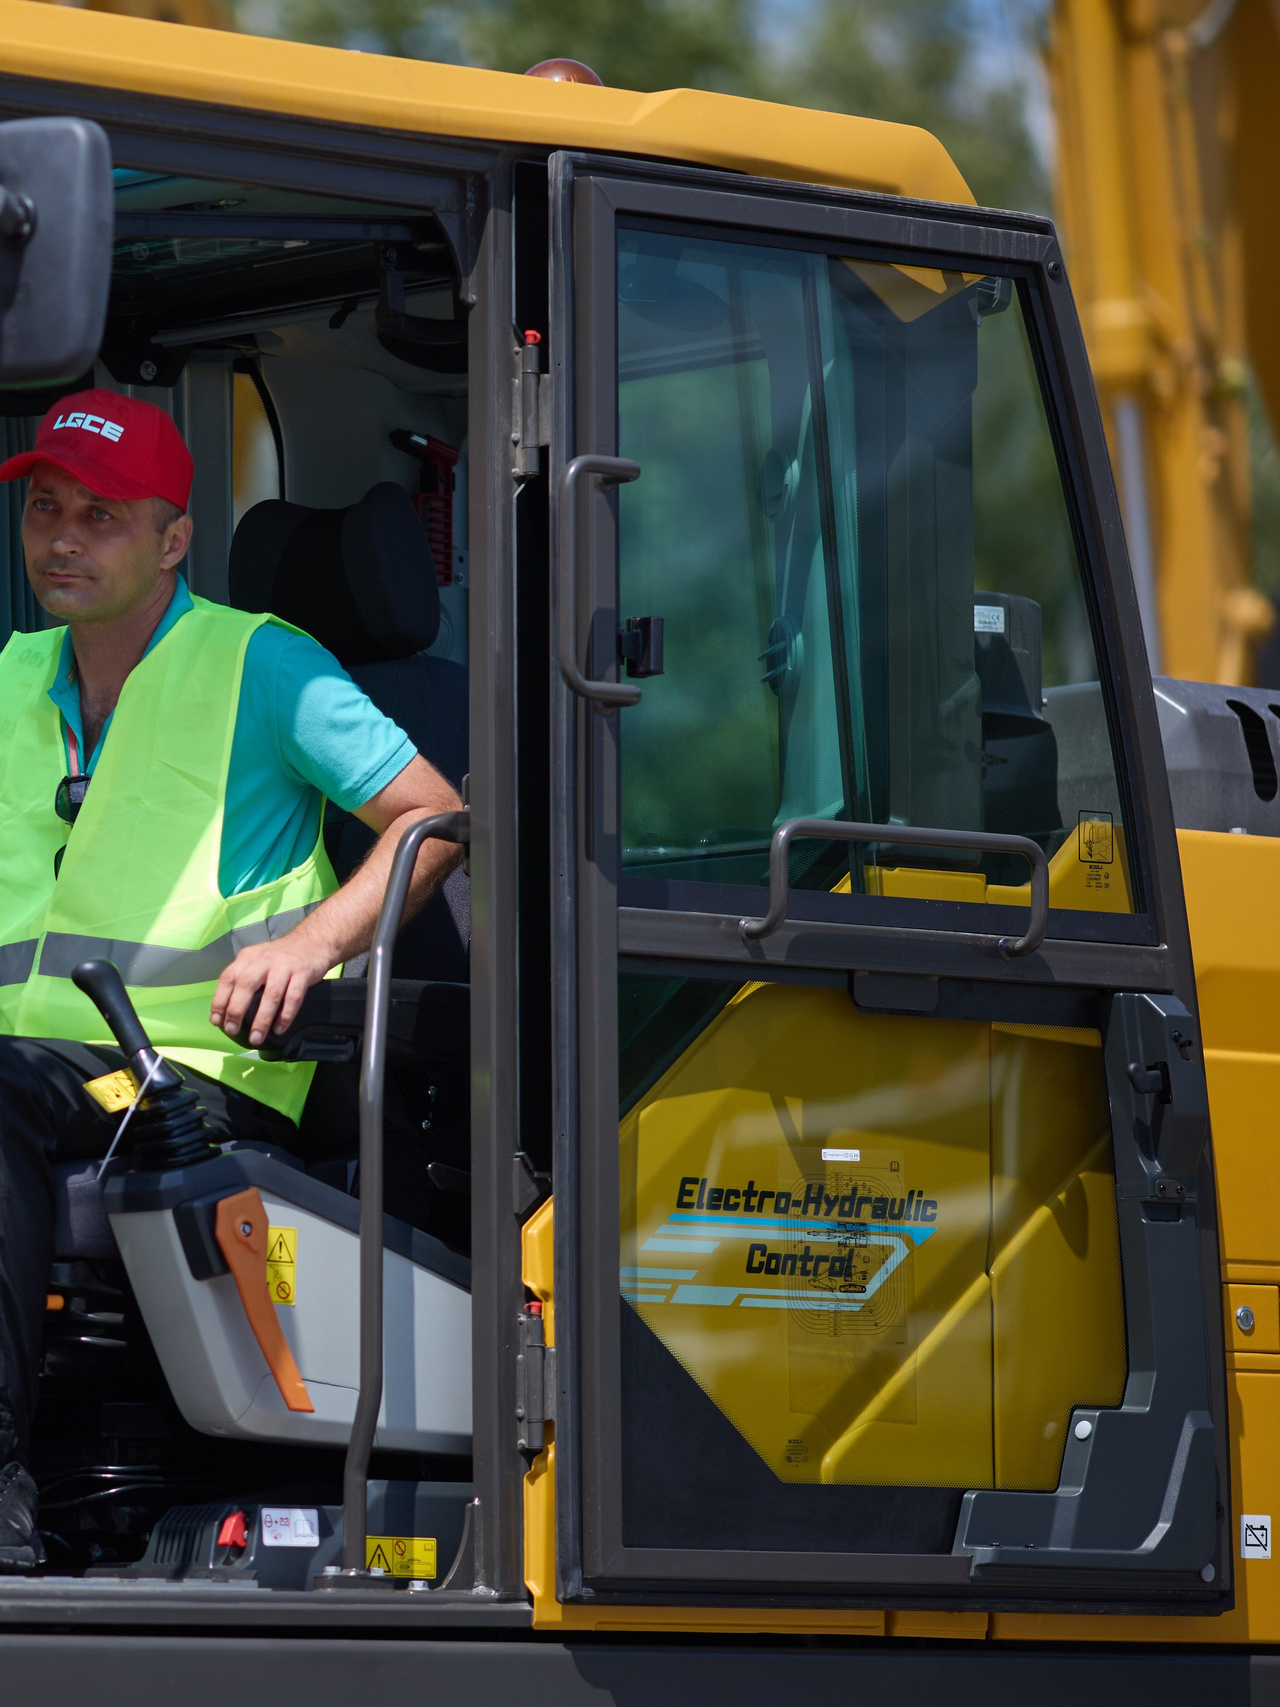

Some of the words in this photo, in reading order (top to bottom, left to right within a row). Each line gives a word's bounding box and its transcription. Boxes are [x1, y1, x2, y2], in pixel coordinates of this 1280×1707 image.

[53, 412, 125, 443] LGCE
[676, 1177, 938, 1222] Electro-Hydraulic
[745, 1243, 855, 1279] Control
